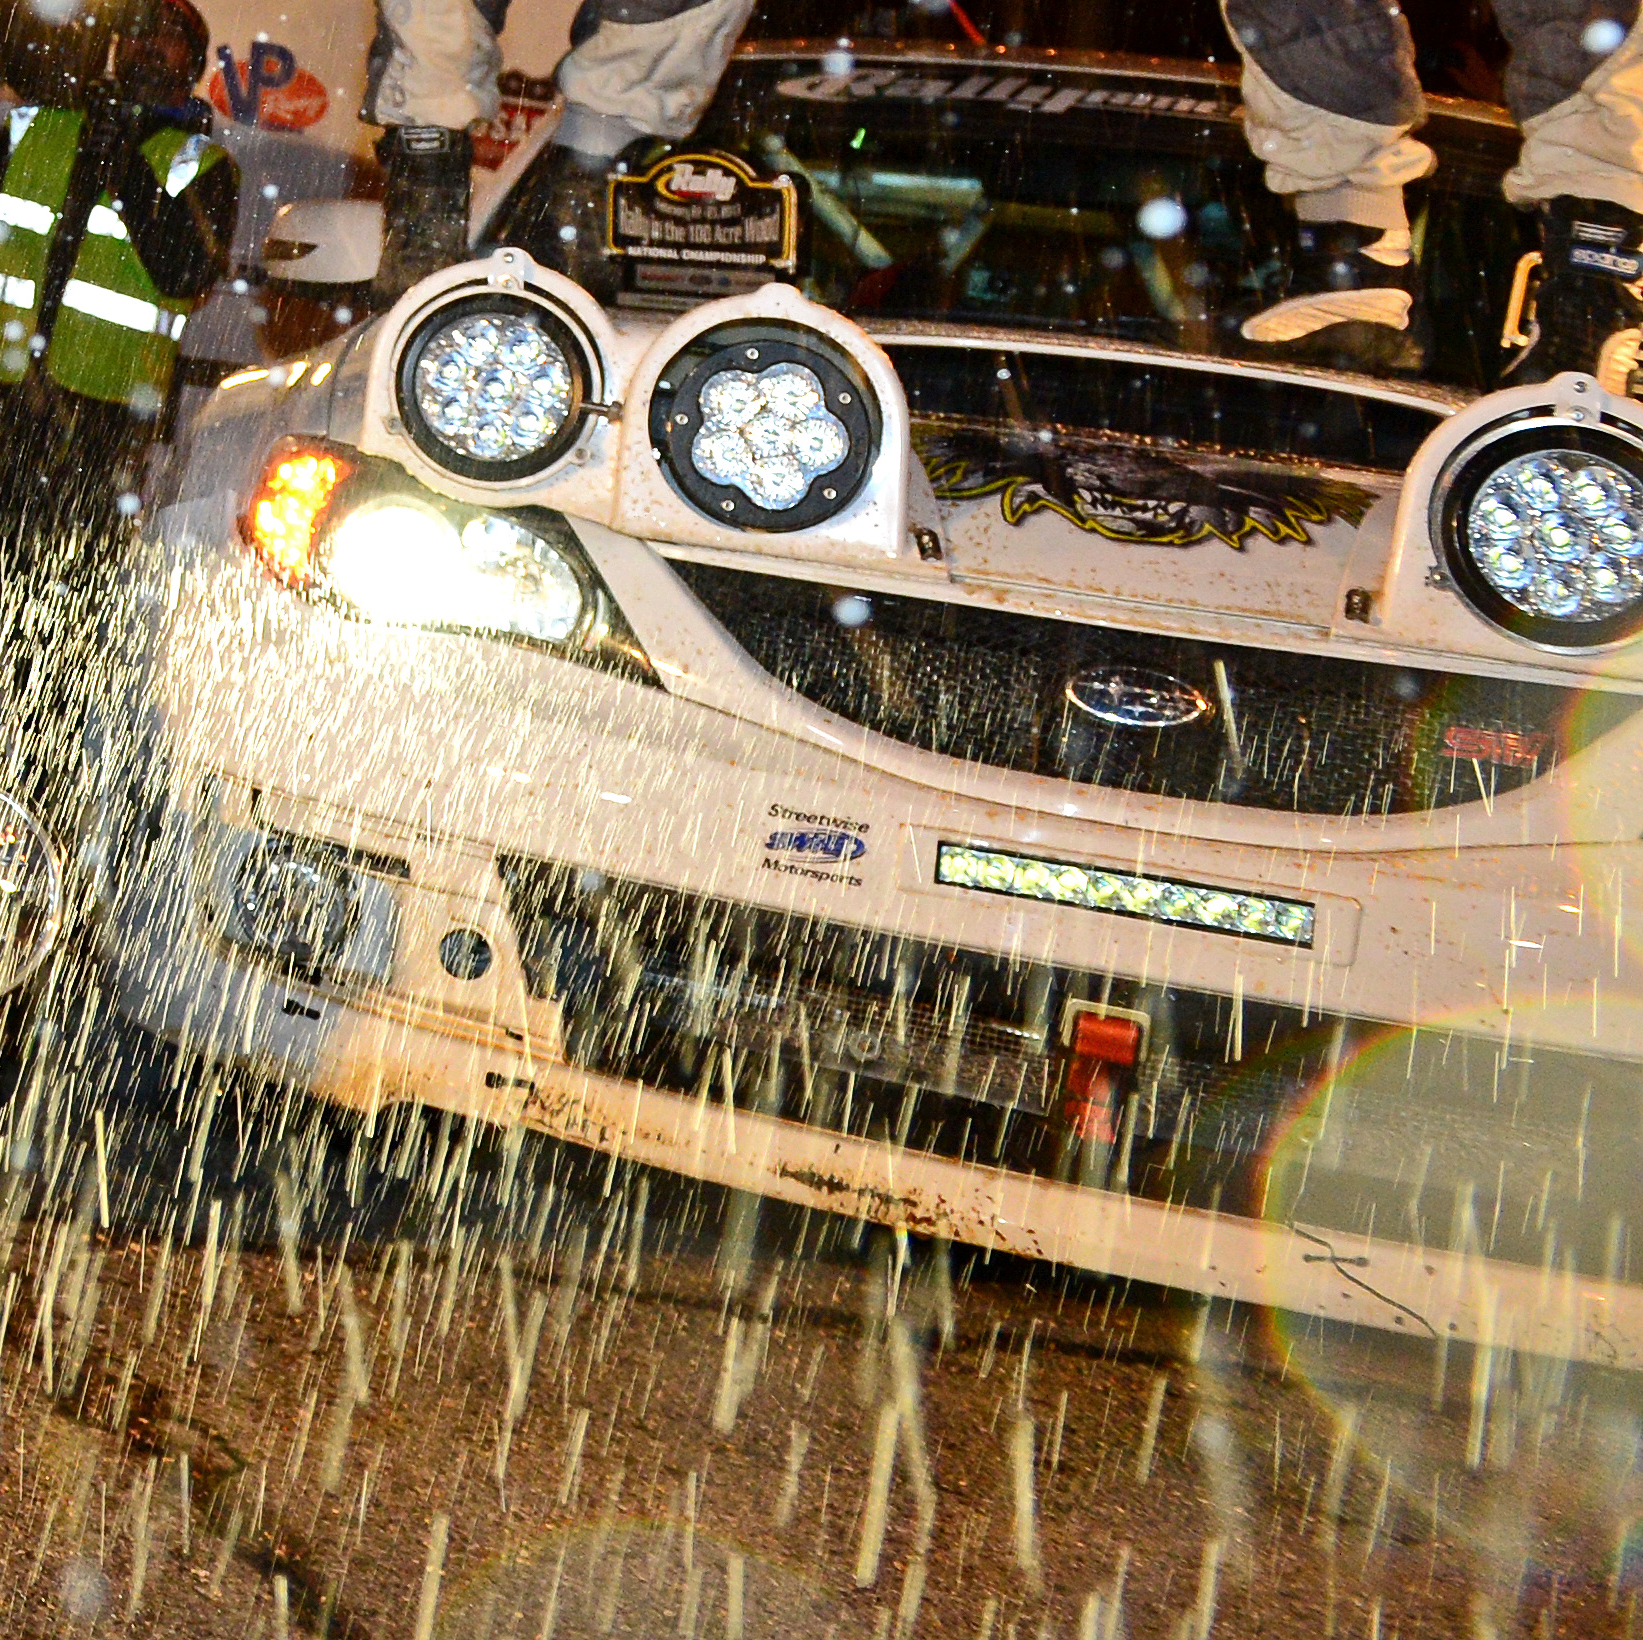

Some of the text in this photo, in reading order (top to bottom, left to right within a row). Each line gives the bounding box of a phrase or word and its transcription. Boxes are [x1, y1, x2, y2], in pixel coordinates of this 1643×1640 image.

[216, 40, 298, 127] VP
[669, 163, 737, 202] Rally
[627, 245, 766, 265] NATIONAL CHAMPIONSHIP
[767, 802, 871, 834] Streetwise
[761, 858, 864, 888] Motorsports
